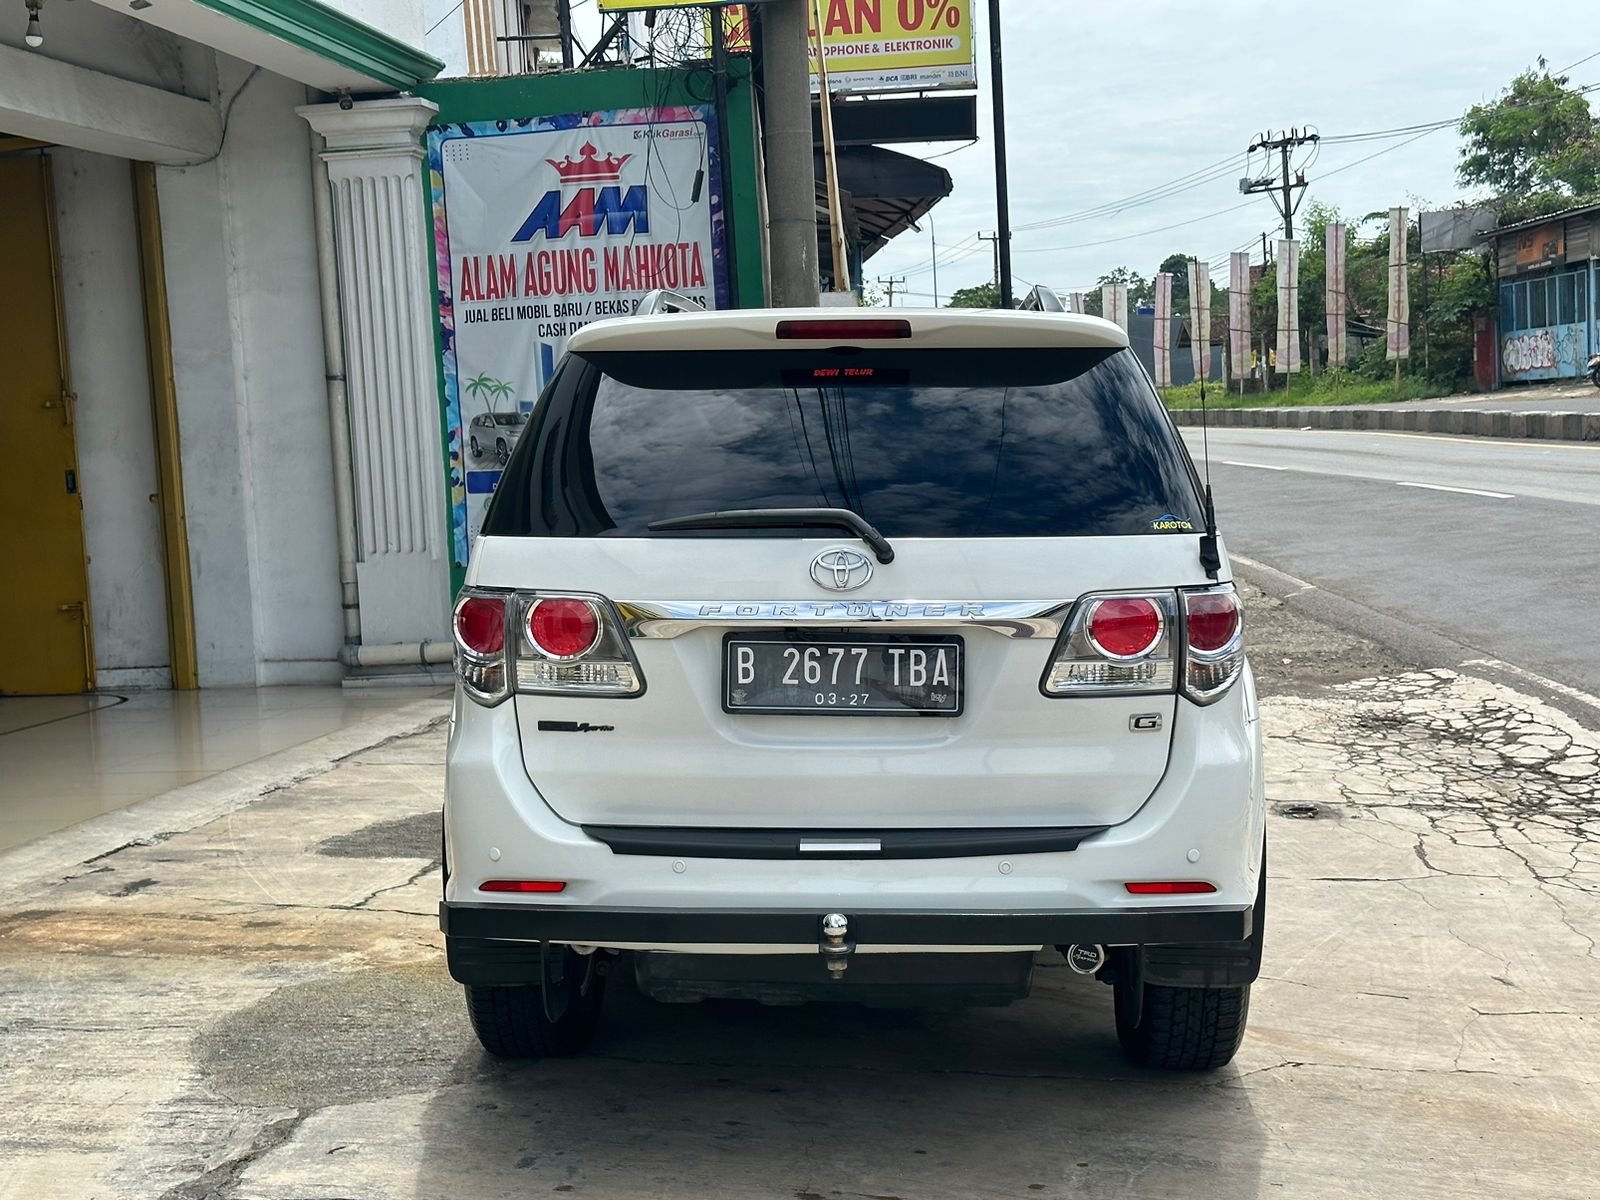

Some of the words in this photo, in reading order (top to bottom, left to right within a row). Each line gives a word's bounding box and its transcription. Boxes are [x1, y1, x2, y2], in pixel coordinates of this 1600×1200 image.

[897, 0, 961, 31] 0%
[872, 43, 880, 54] &
[884, 38, 954, 53] ELEKTRONIK
[510, 185, 649, 242] AAM
[460, 254, 517, 301] ALAM
[524, 247, 597, 297] AGUNG
[603, 242, 706, 292] MAHKOTA
[464, 308, 489, 324] JUAL
[491, 307, 514, 322] BELI
[517, 304, 551, 320] MOBIL
[554, 302, 583, 317] BARU
[595, 299, 629, 315] BEKAS
[538, 322, 567, 337] CASH
[814, 369, 840, 377] DEWI
[844, 368, 874, 376] TELUR
[698, 604, 986, 617] FORTUNER
[737, 647, 755, 685] B
[782, 647, 868, 686] 2677
[888, 648, 949, 687] TBA
[1134, 716, 1157, 729] G
